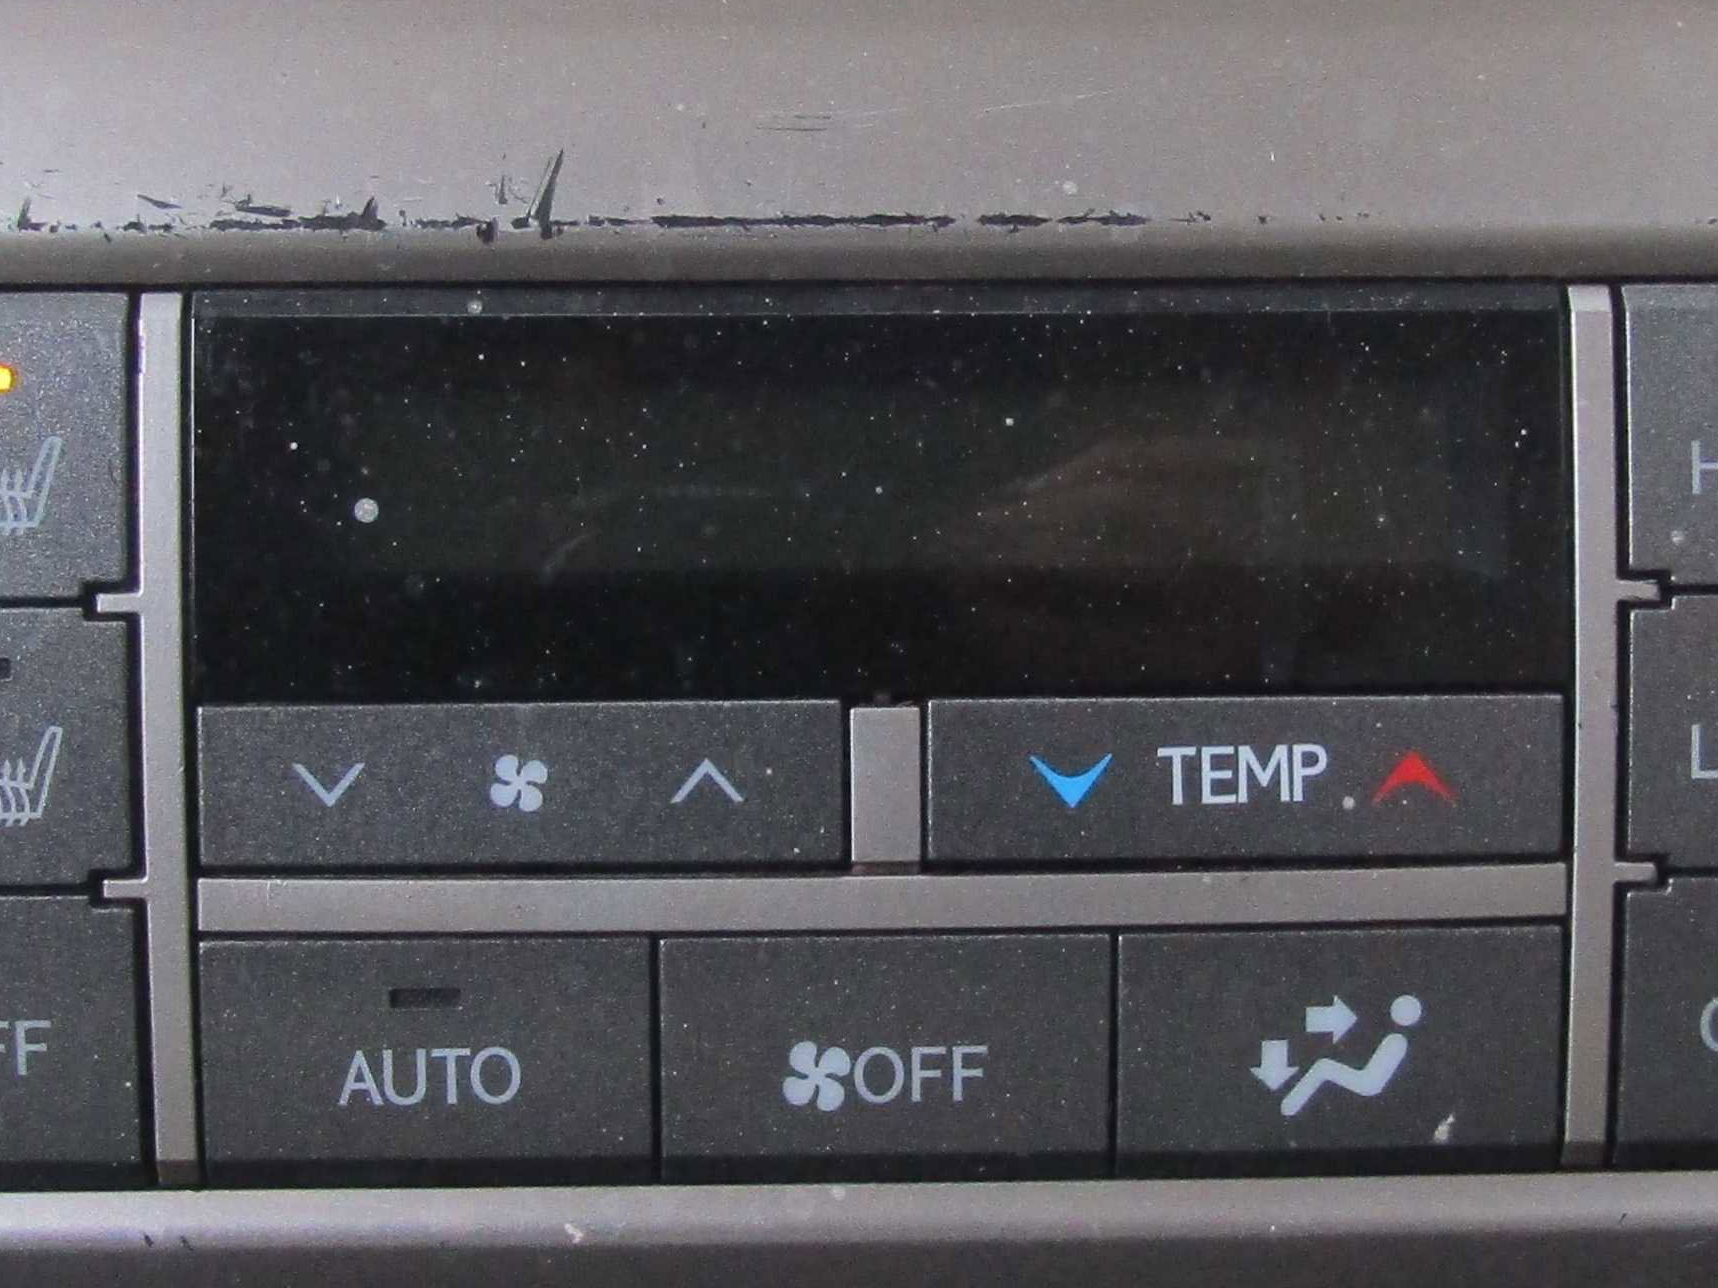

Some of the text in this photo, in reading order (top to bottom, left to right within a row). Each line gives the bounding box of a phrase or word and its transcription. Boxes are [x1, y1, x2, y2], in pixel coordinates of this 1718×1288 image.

[1157, 742, 1328, 806] TEMP
[338, 1046, 523, 1106] AUTO
[853, 1045, 989, 1104] OFF
